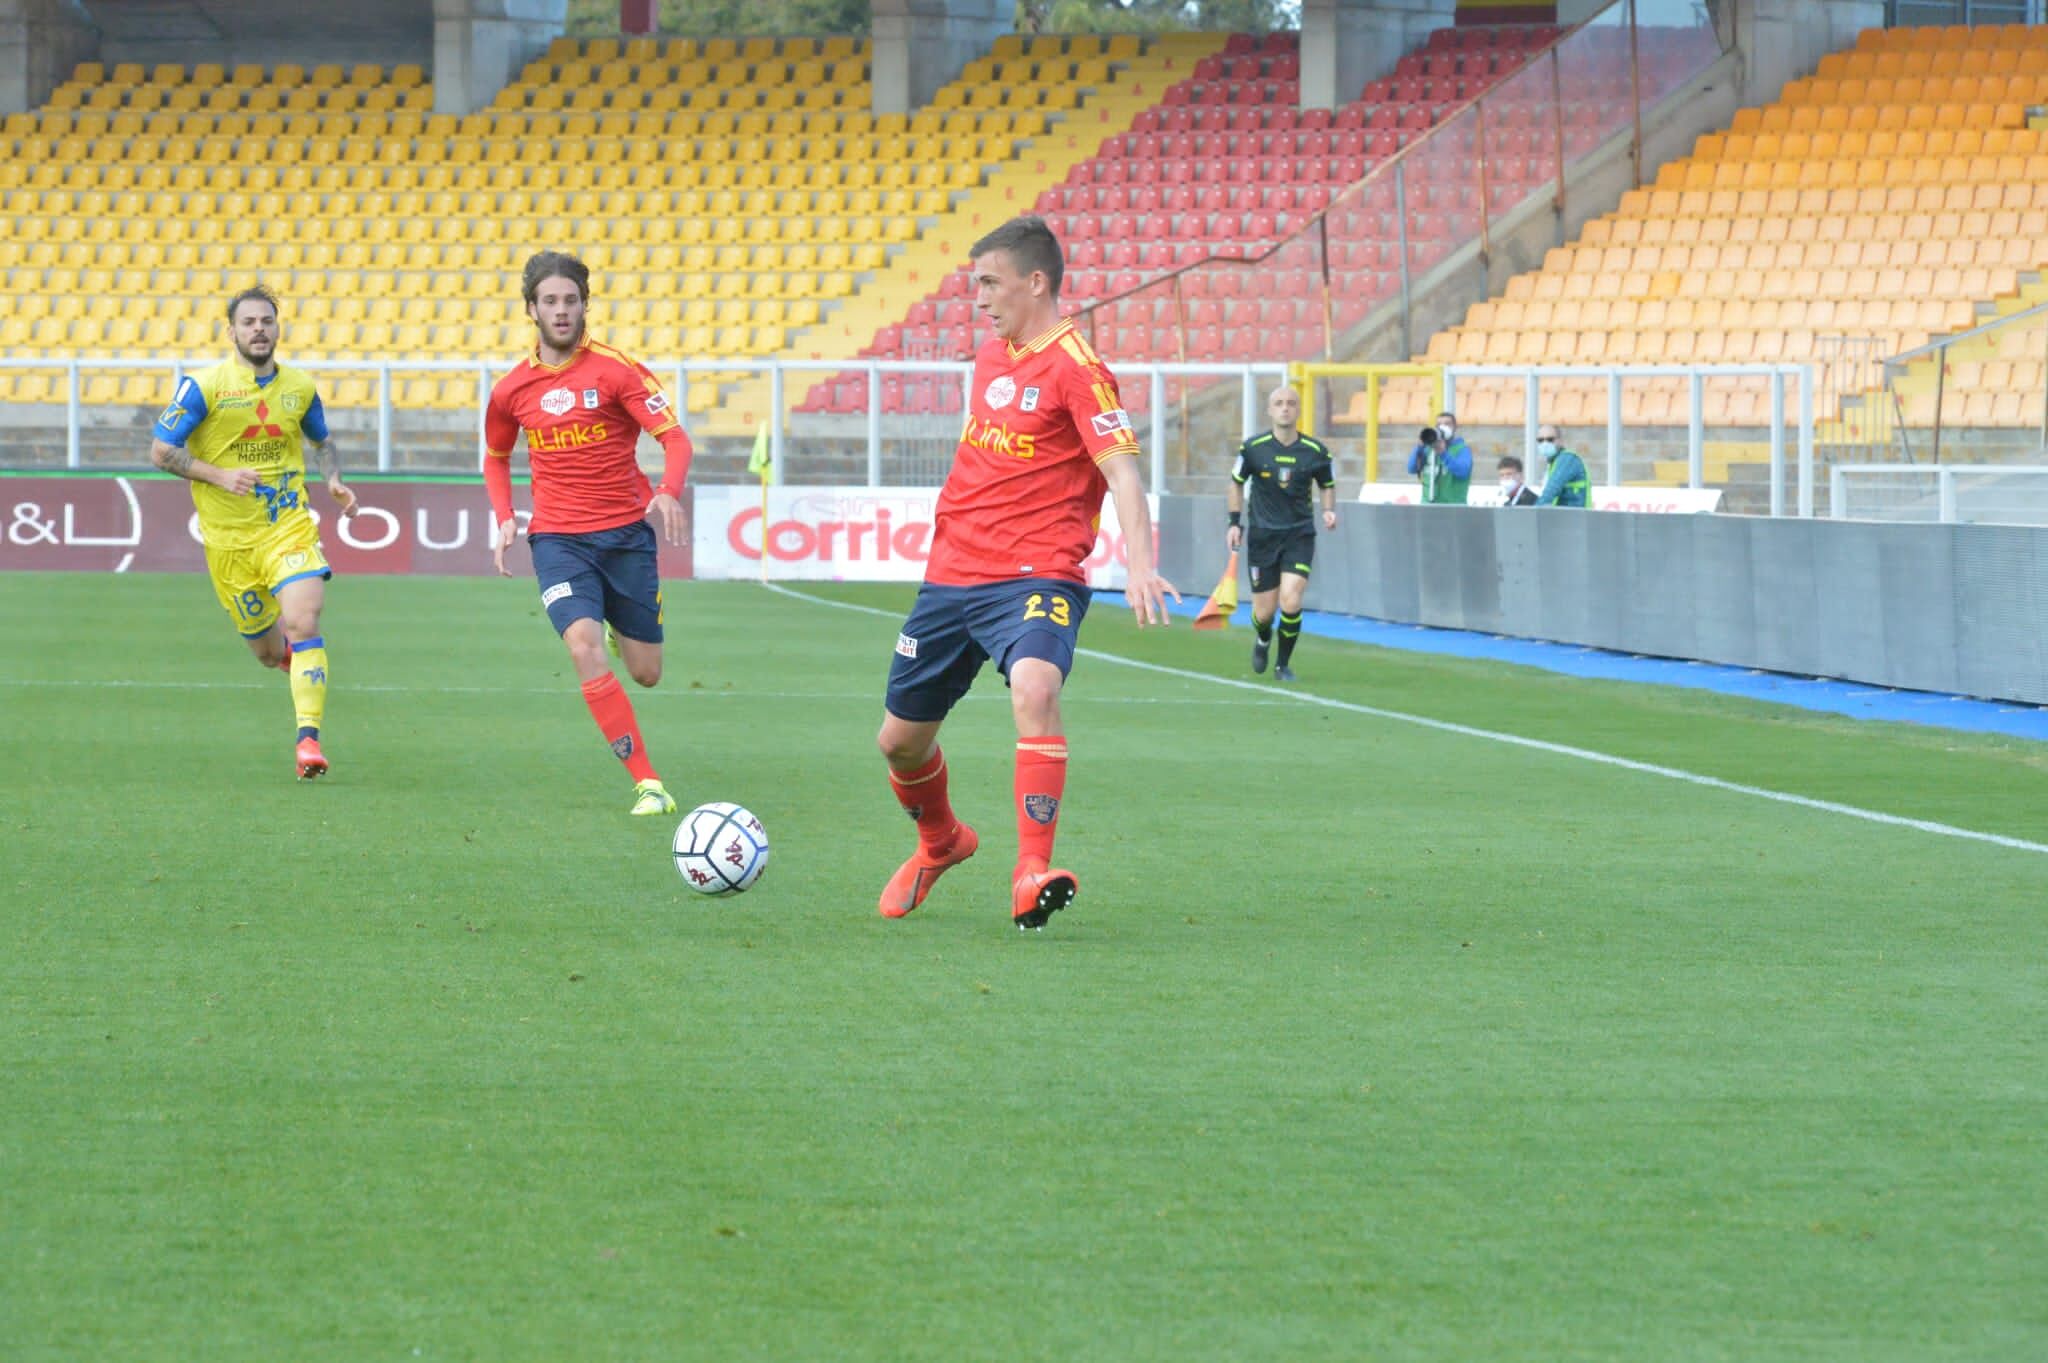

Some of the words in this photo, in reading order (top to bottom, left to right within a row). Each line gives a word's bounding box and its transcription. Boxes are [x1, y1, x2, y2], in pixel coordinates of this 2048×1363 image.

[238, 452, 281, 463] MOTORS
[727, 506, 935, 562] Corrie
[233, 590, 264, 621] 18
[1023, 594, 1071, 627] 23
